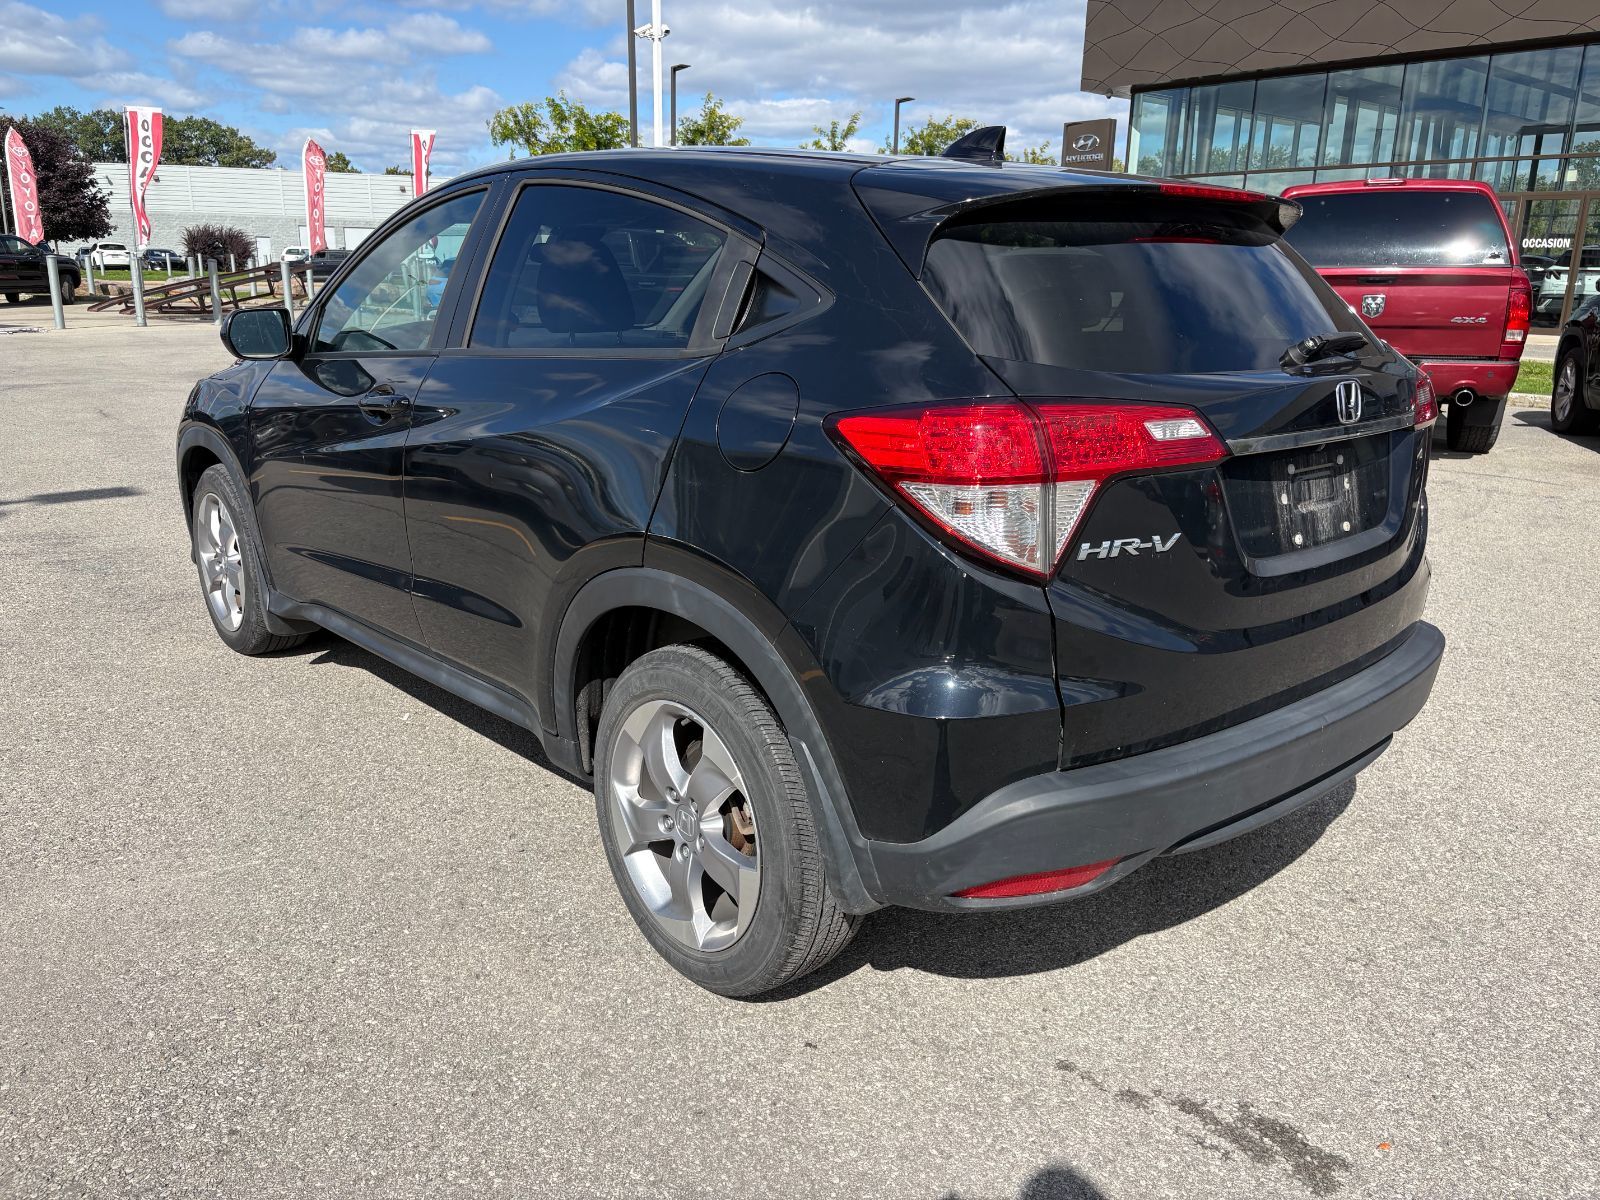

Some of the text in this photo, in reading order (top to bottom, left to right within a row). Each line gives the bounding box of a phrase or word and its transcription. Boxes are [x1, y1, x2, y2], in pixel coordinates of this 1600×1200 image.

[1065, 153, 1104, 163] HYUNDAI
[20, 160, 39, 239] TOYOTA
[313, 169, 321, 246] TOYOTA
[1522, 238, 1571, 249] OCCASION
[1076, 532, 1182, 561] HR-V
